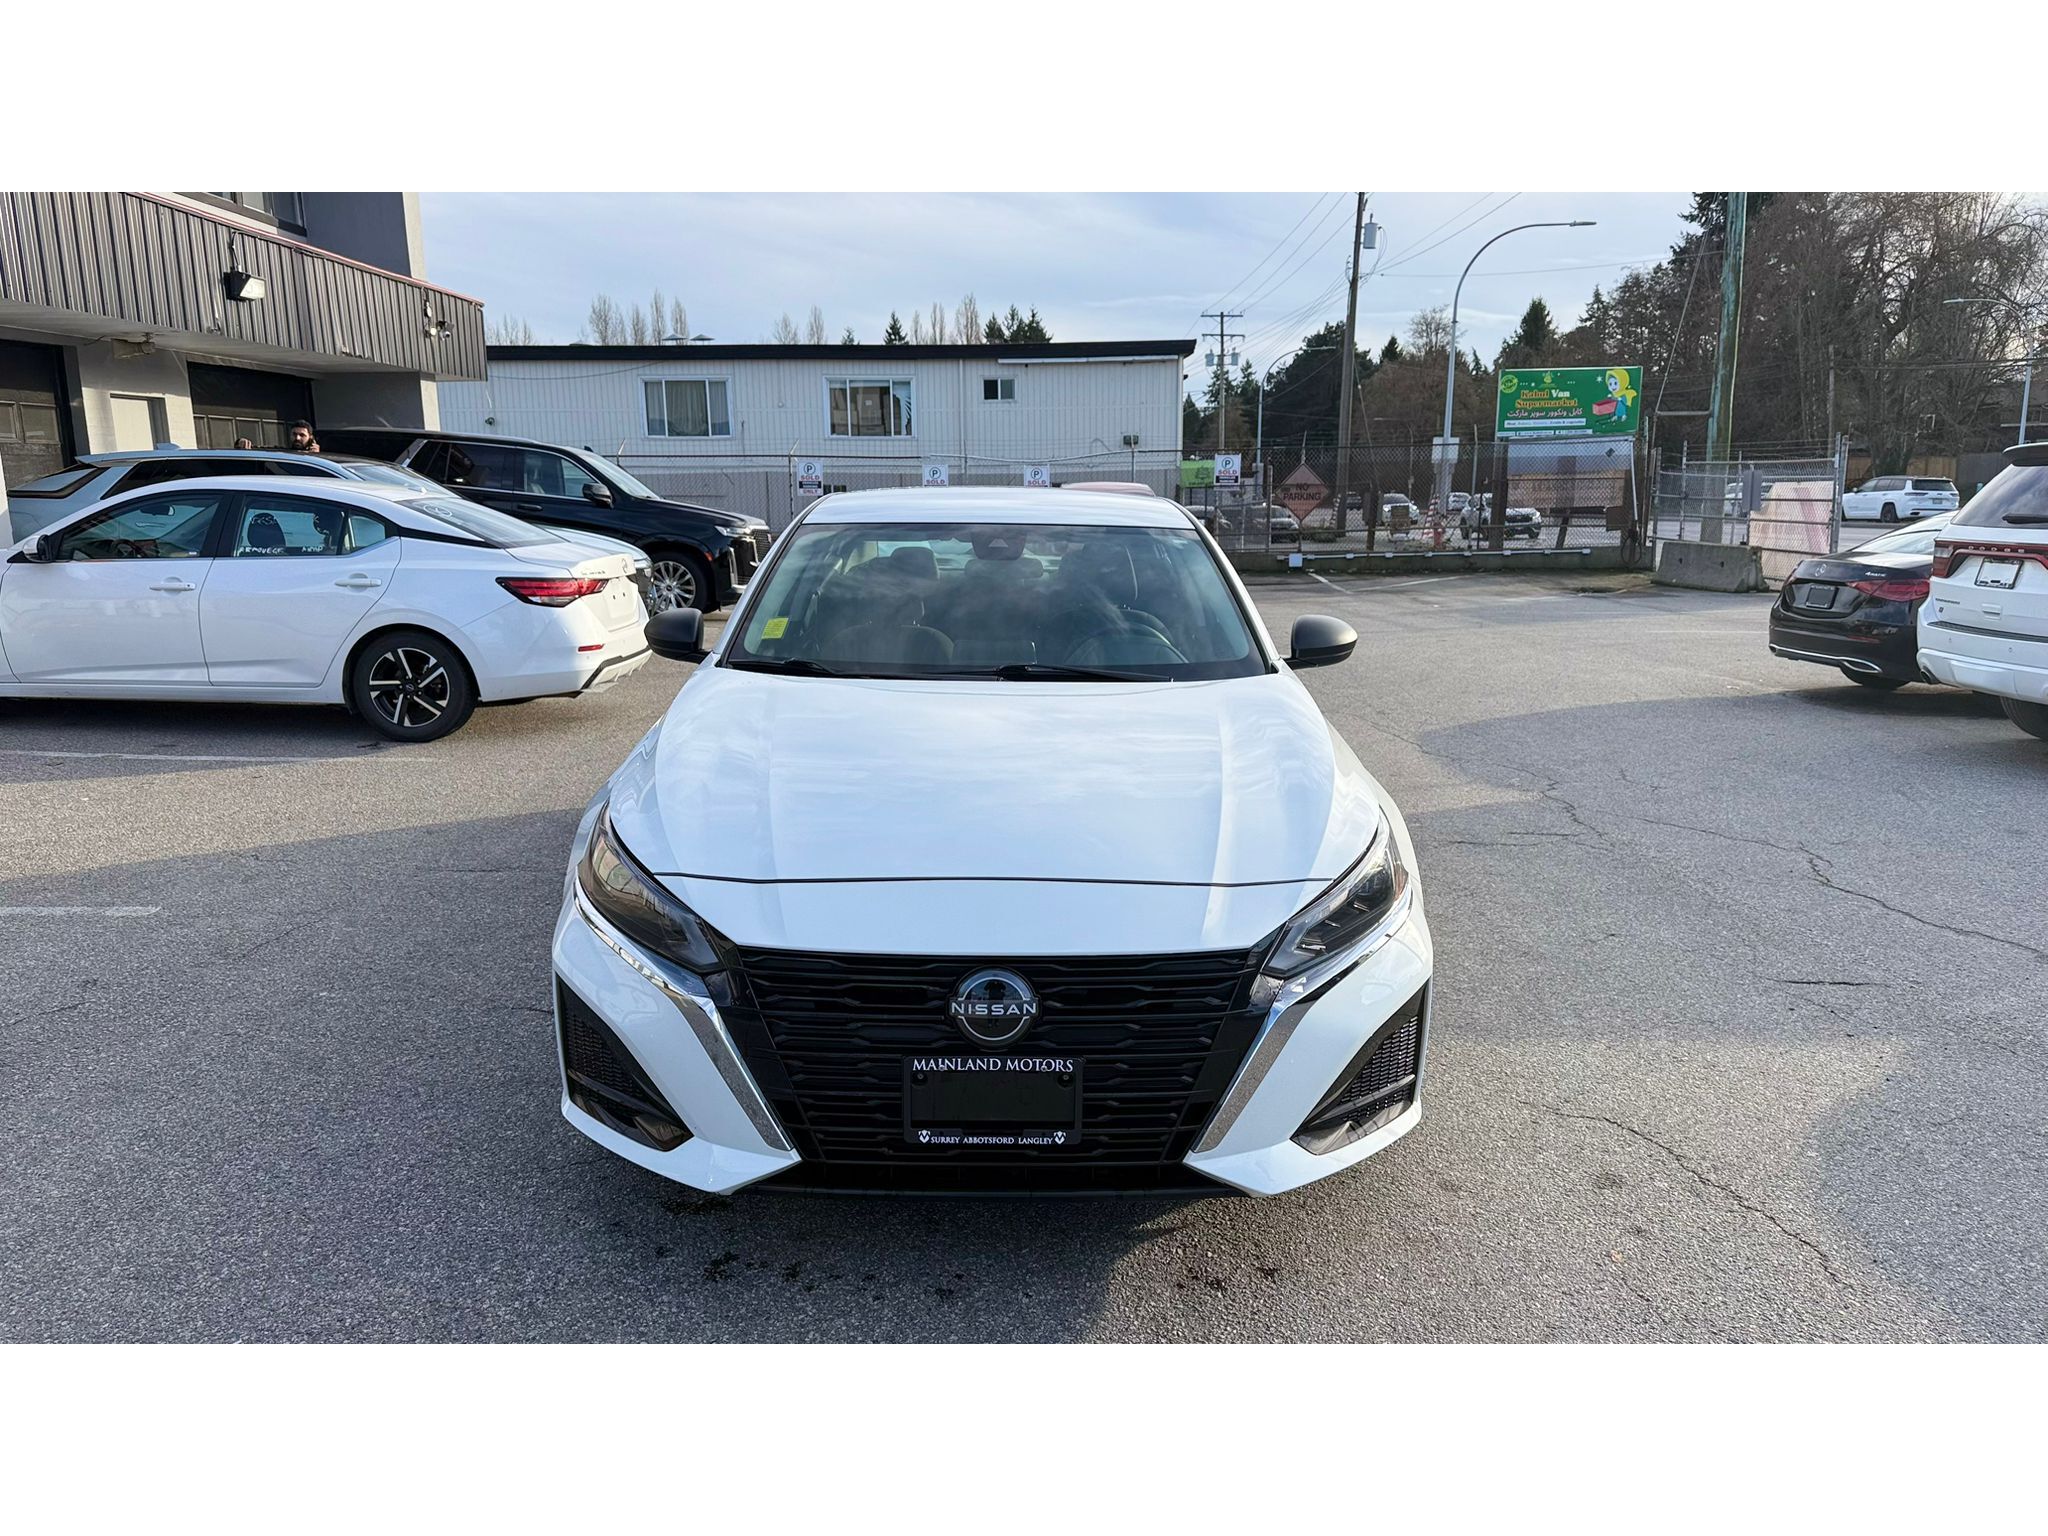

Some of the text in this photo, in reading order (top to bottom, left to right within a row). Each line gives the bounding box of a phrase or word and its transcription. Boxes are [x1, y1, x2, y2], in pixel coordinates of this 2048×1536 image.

[1551, 389, 1570, 398] Van
[1515, 398, 1578, 410] Supermarket
[1296, 483, 1310, 491] NO
[1283, 492, 1321, 501] PARKING
[951, 1002, 1037, 1015] NISSAN
[912, 1058, 1074, 1072] MAINLAND MOTORS
